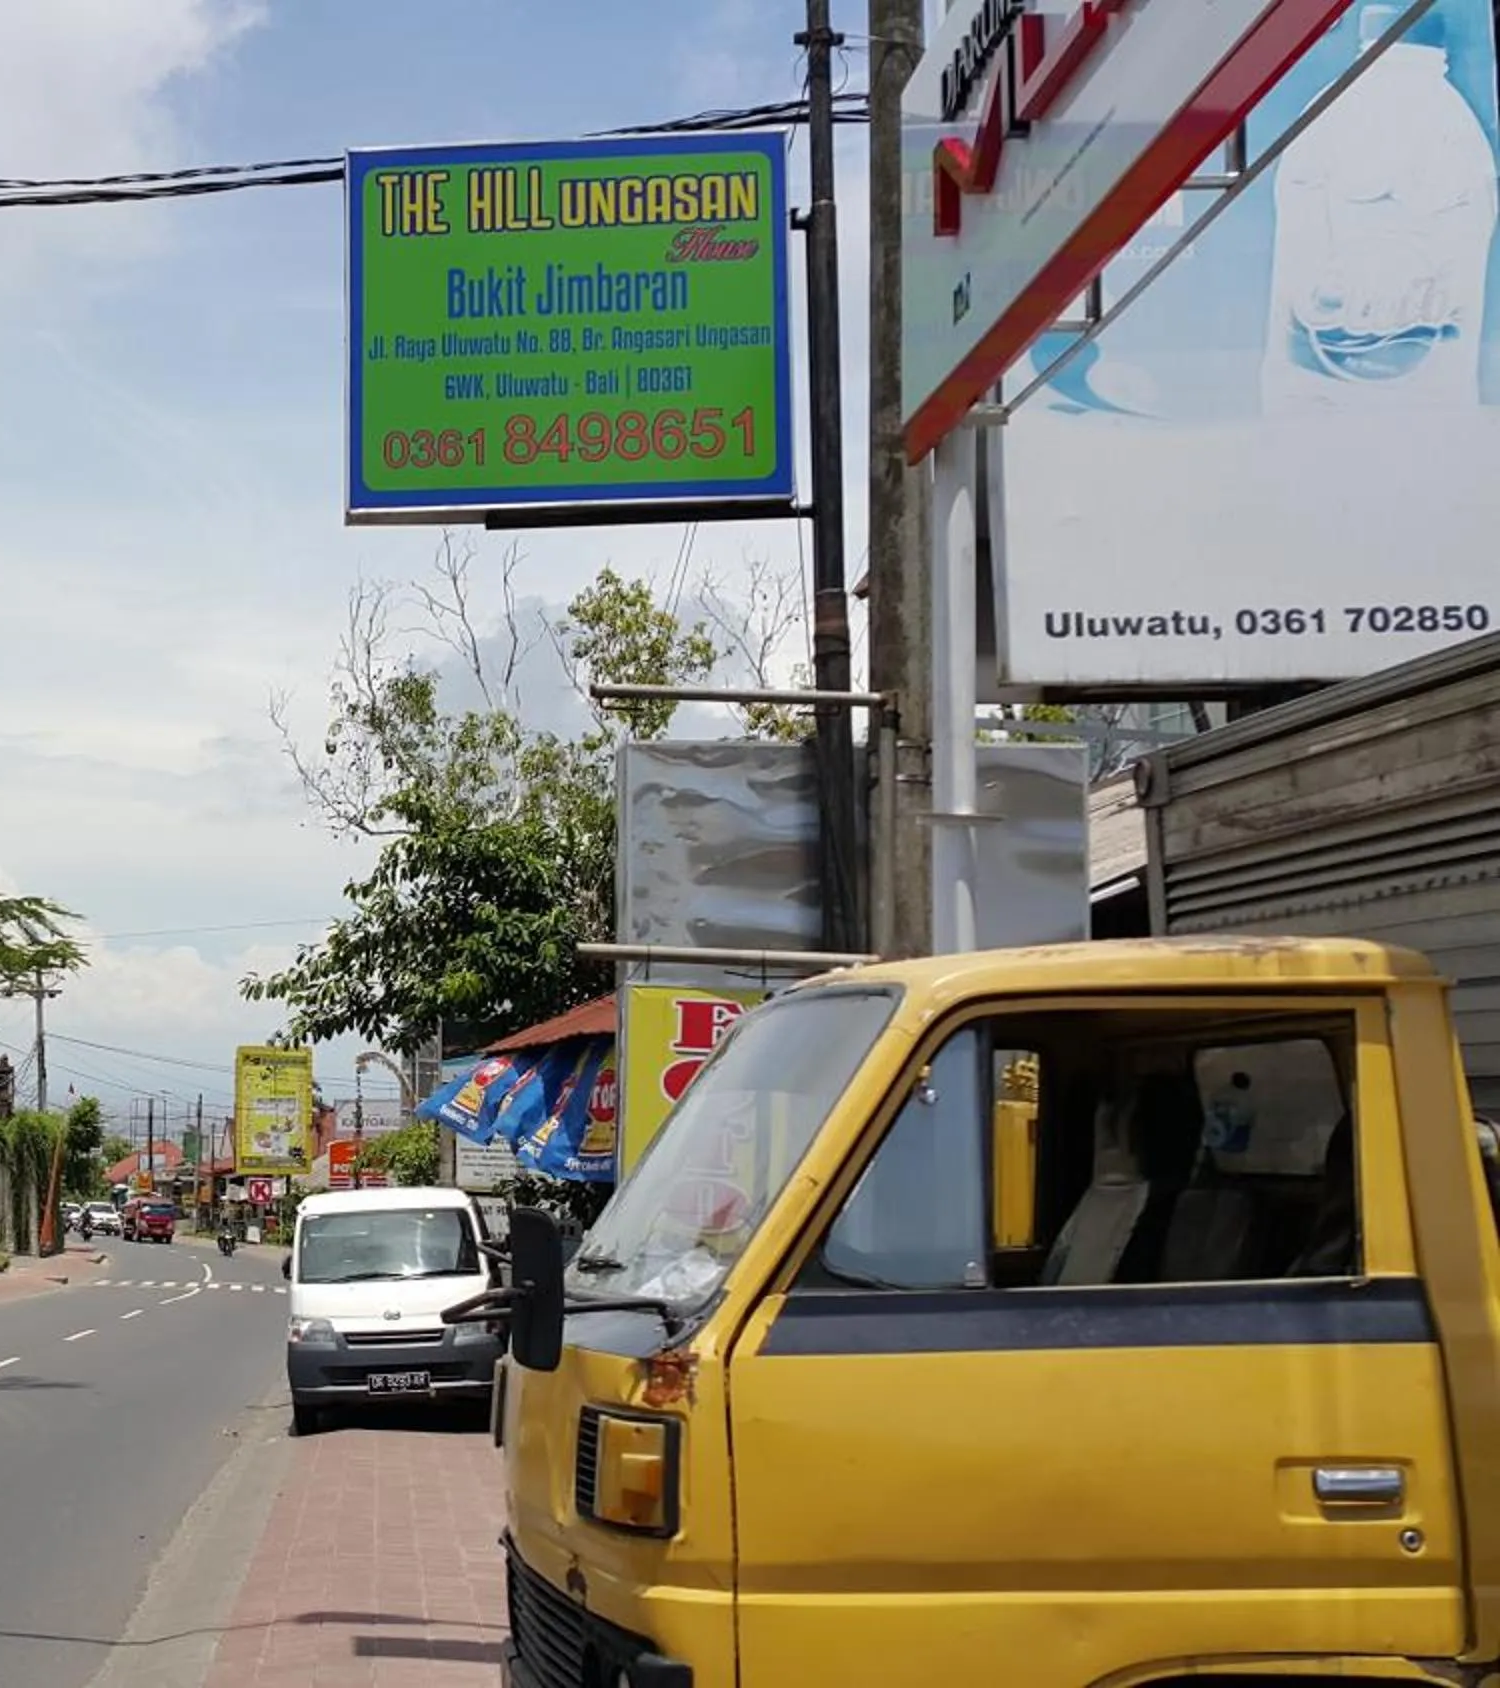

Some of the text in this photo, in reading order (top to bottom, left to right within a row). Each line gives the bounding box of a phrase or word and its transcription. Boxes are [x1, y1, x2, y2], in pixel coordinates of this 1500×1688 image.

[378, 167, 758, 236] THE HILL UNGASAN
[447, 262, 688, 319] Bukit Jimbaran
[395, 336, 436, 362] Raya
[442, 332, 510, 357] Uluwatu
[516, 330, 543, 354] No.
[611, 323, 690, 352] Angasari
[695, 323, 771, 351] Ungasan
[496, 371, 568, 398] Uluwatu
[585, 367, 619, 395] Bali
[637, 366, 692, 393] 80361
[383, 406, 755, 469] 0361 8498651
[1045, 604, 1490, 641] Uluwatu, 0361 702850
